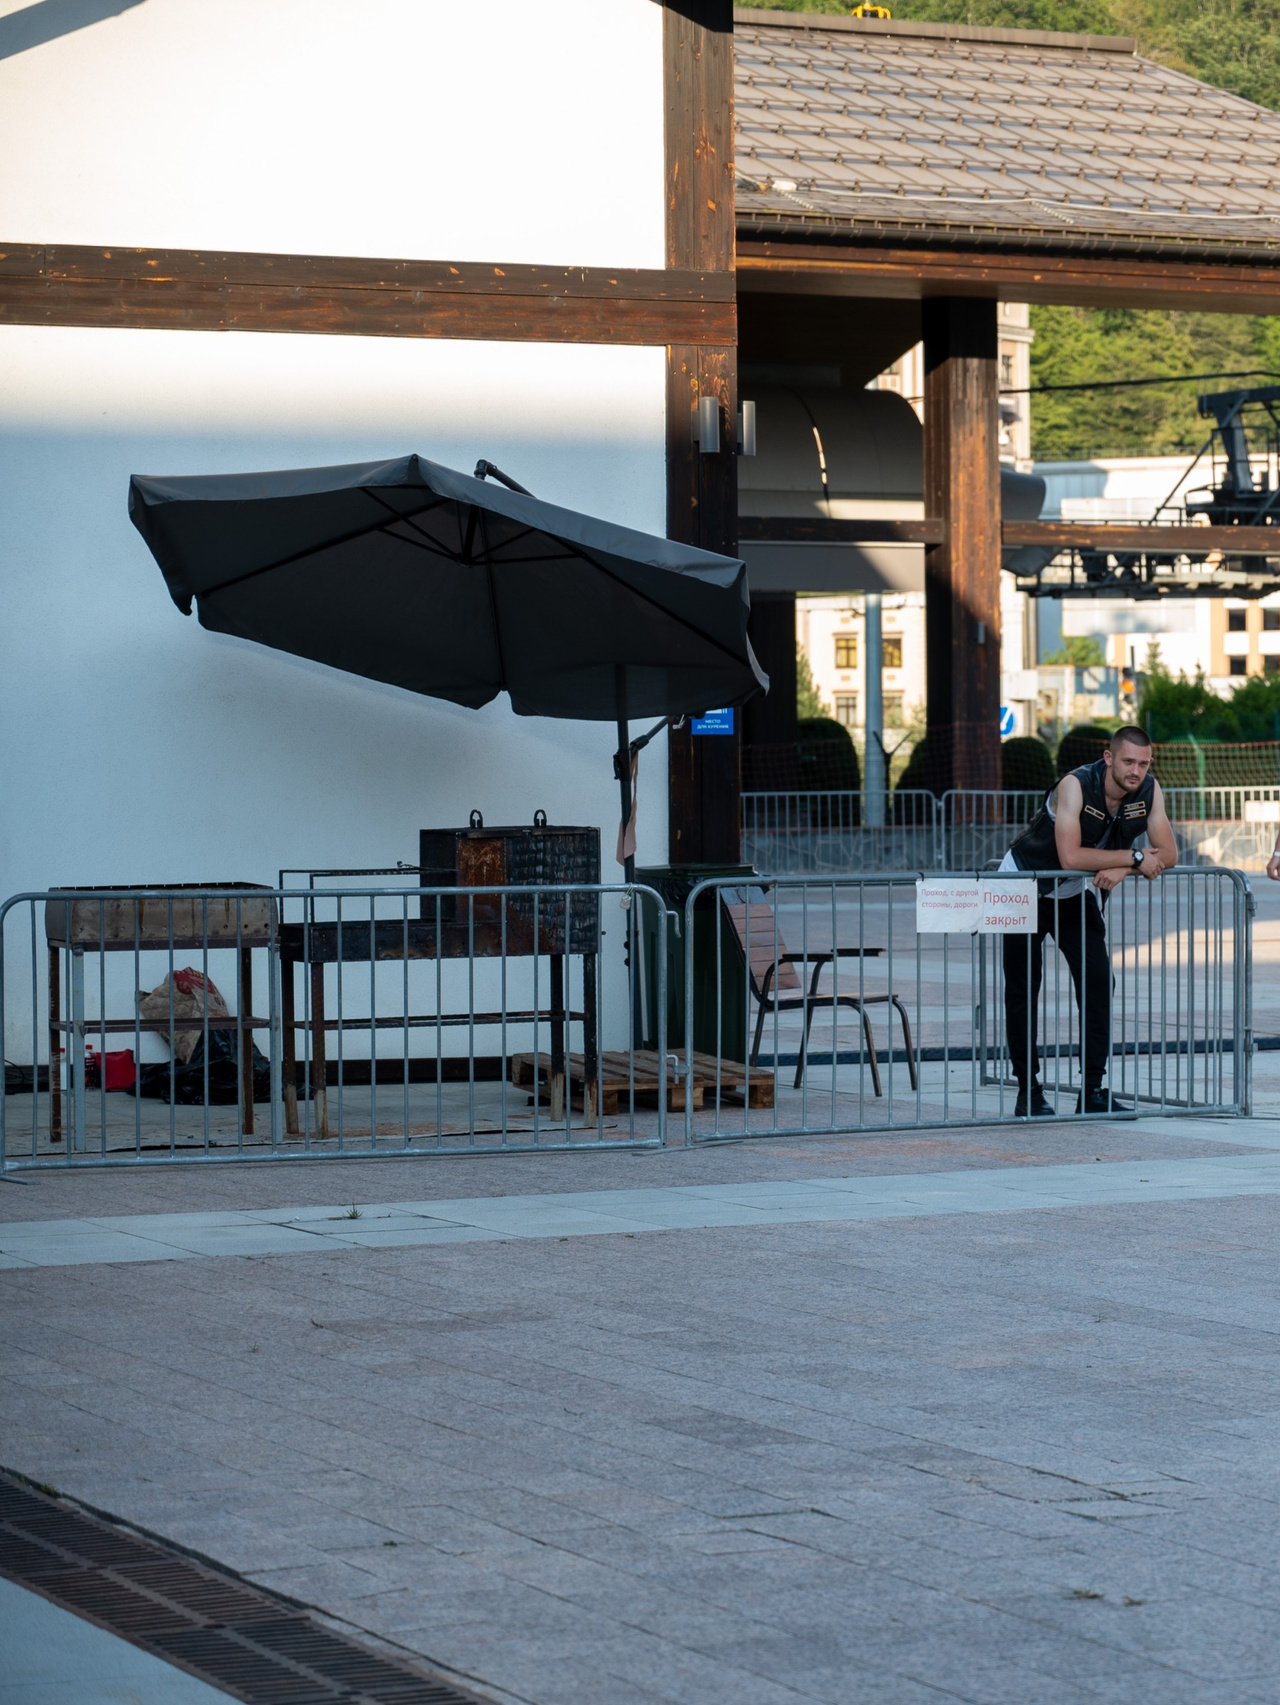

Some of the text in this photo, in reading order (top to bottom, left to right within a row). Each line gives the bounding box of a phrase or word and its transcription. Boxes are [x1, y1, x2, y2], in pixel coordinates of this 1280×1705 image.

[955, 888, 979, 897] другой
[983, 891, 1029, 905] Проход
[984, 915, 1027, 927] закрыт
